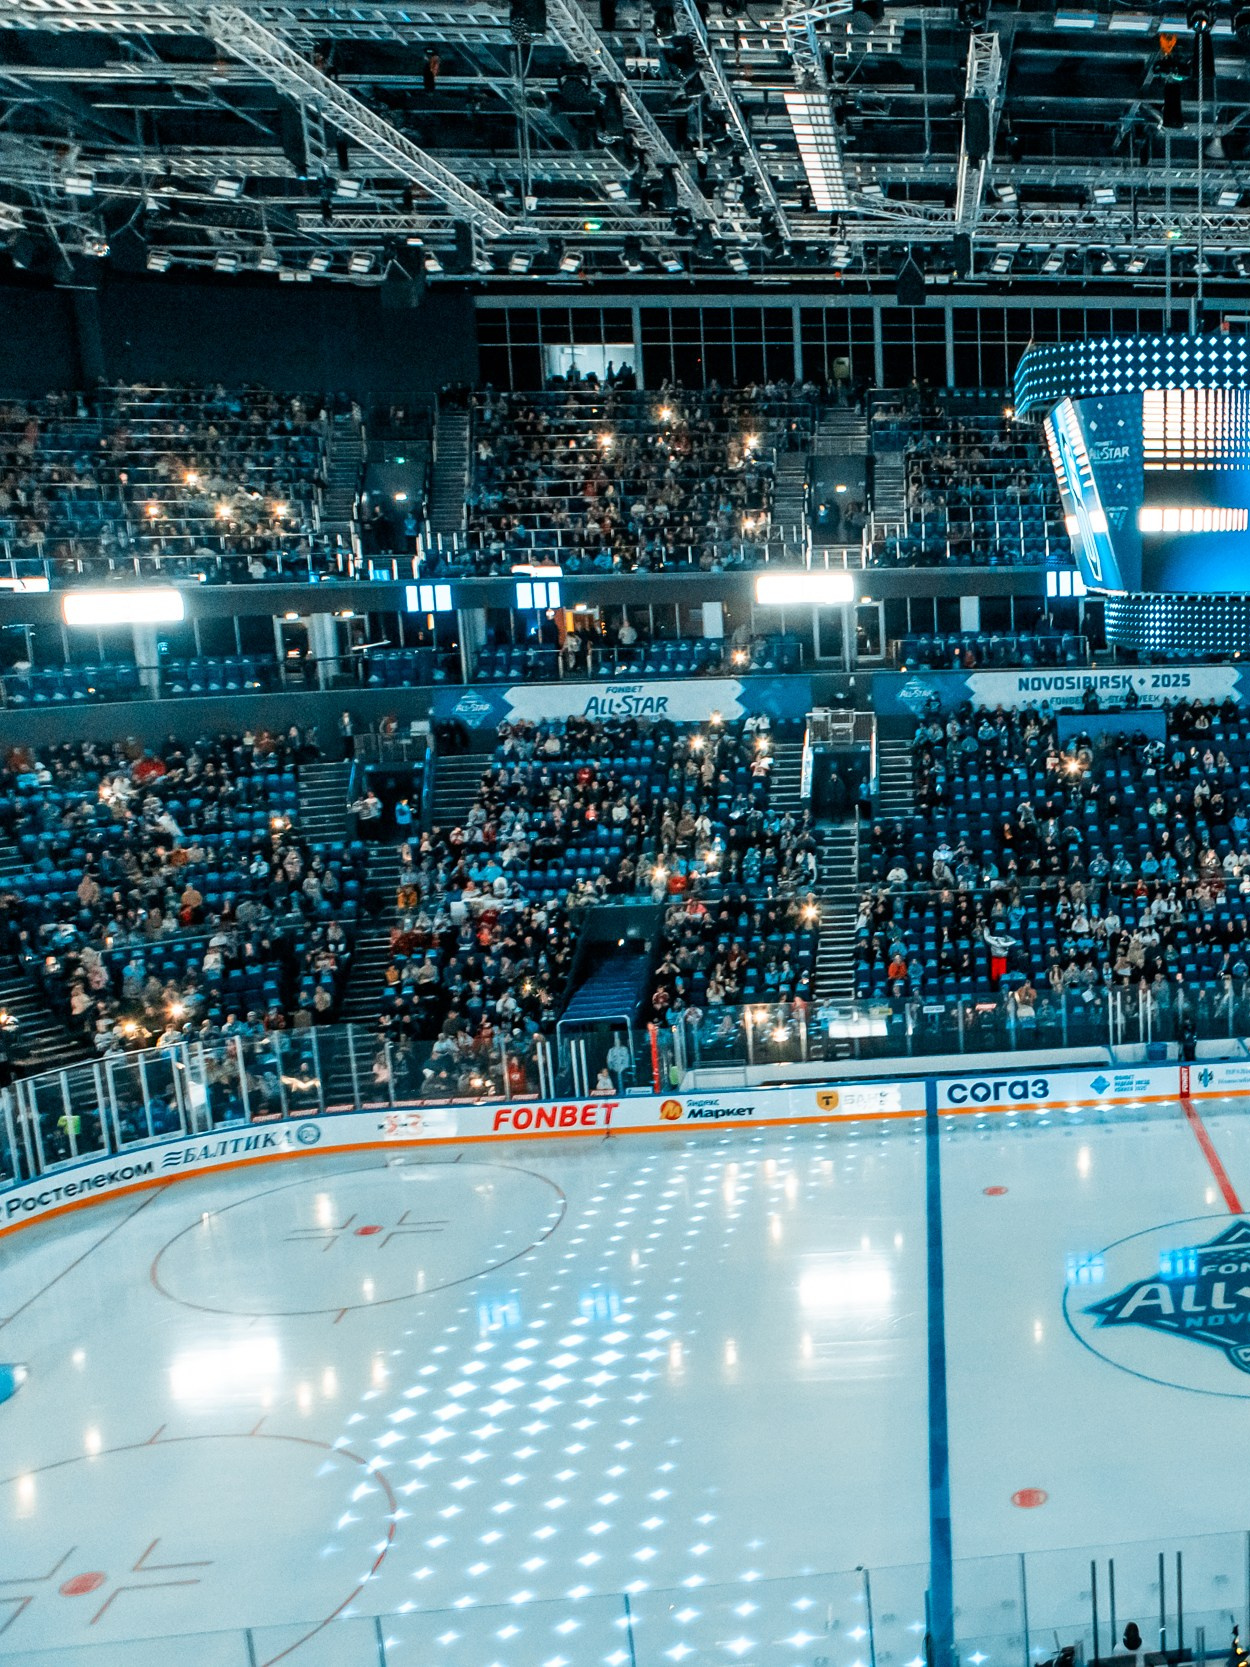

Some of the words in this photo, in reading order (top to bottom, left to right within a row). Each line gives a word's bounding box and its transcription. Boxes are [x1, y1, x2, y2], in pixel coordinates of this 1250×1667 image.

[605, 686, 643, 694] FONBET
[1018, 675, 1133, 691] NOVOSIBIRSK
[1151, 673, 1191, 688] 2025
[493, 1103, 619, 1131] FONBET
[687, 1107, 755, 1119] Маркет
[182, 1130, 292, 1164] БАЛТИКА
[6, 1161, 154, 1219] Ростелеком
